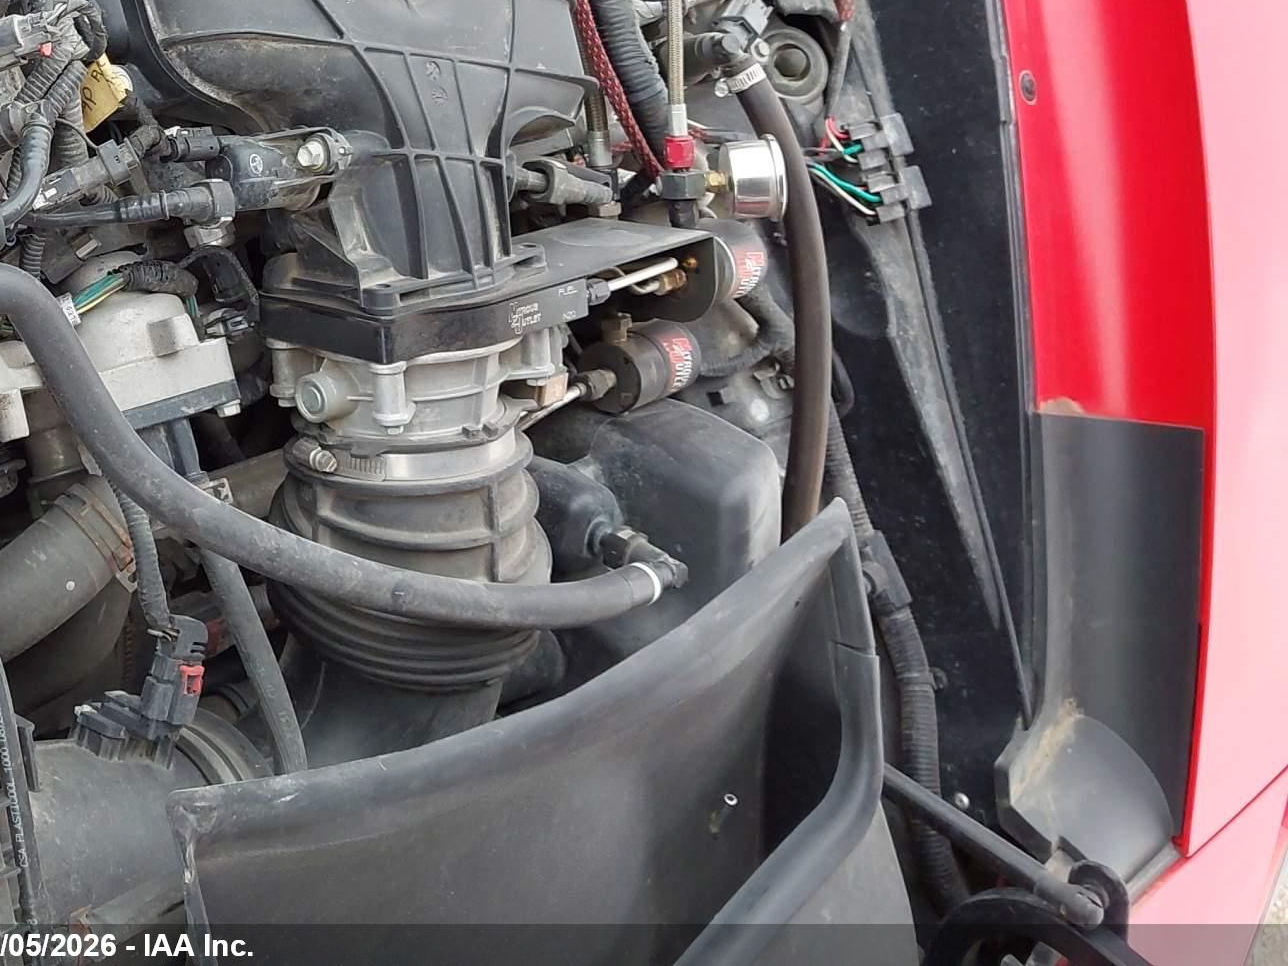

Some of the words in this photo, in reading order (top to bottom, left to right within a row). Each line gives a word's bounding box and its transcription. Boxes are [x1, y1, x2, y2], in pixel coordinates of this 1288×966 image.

[0, 746, 12, 773] 1000
[8, 777, 25, 843] PLASTICOOL
[17, 847, 29, 869] CSA
